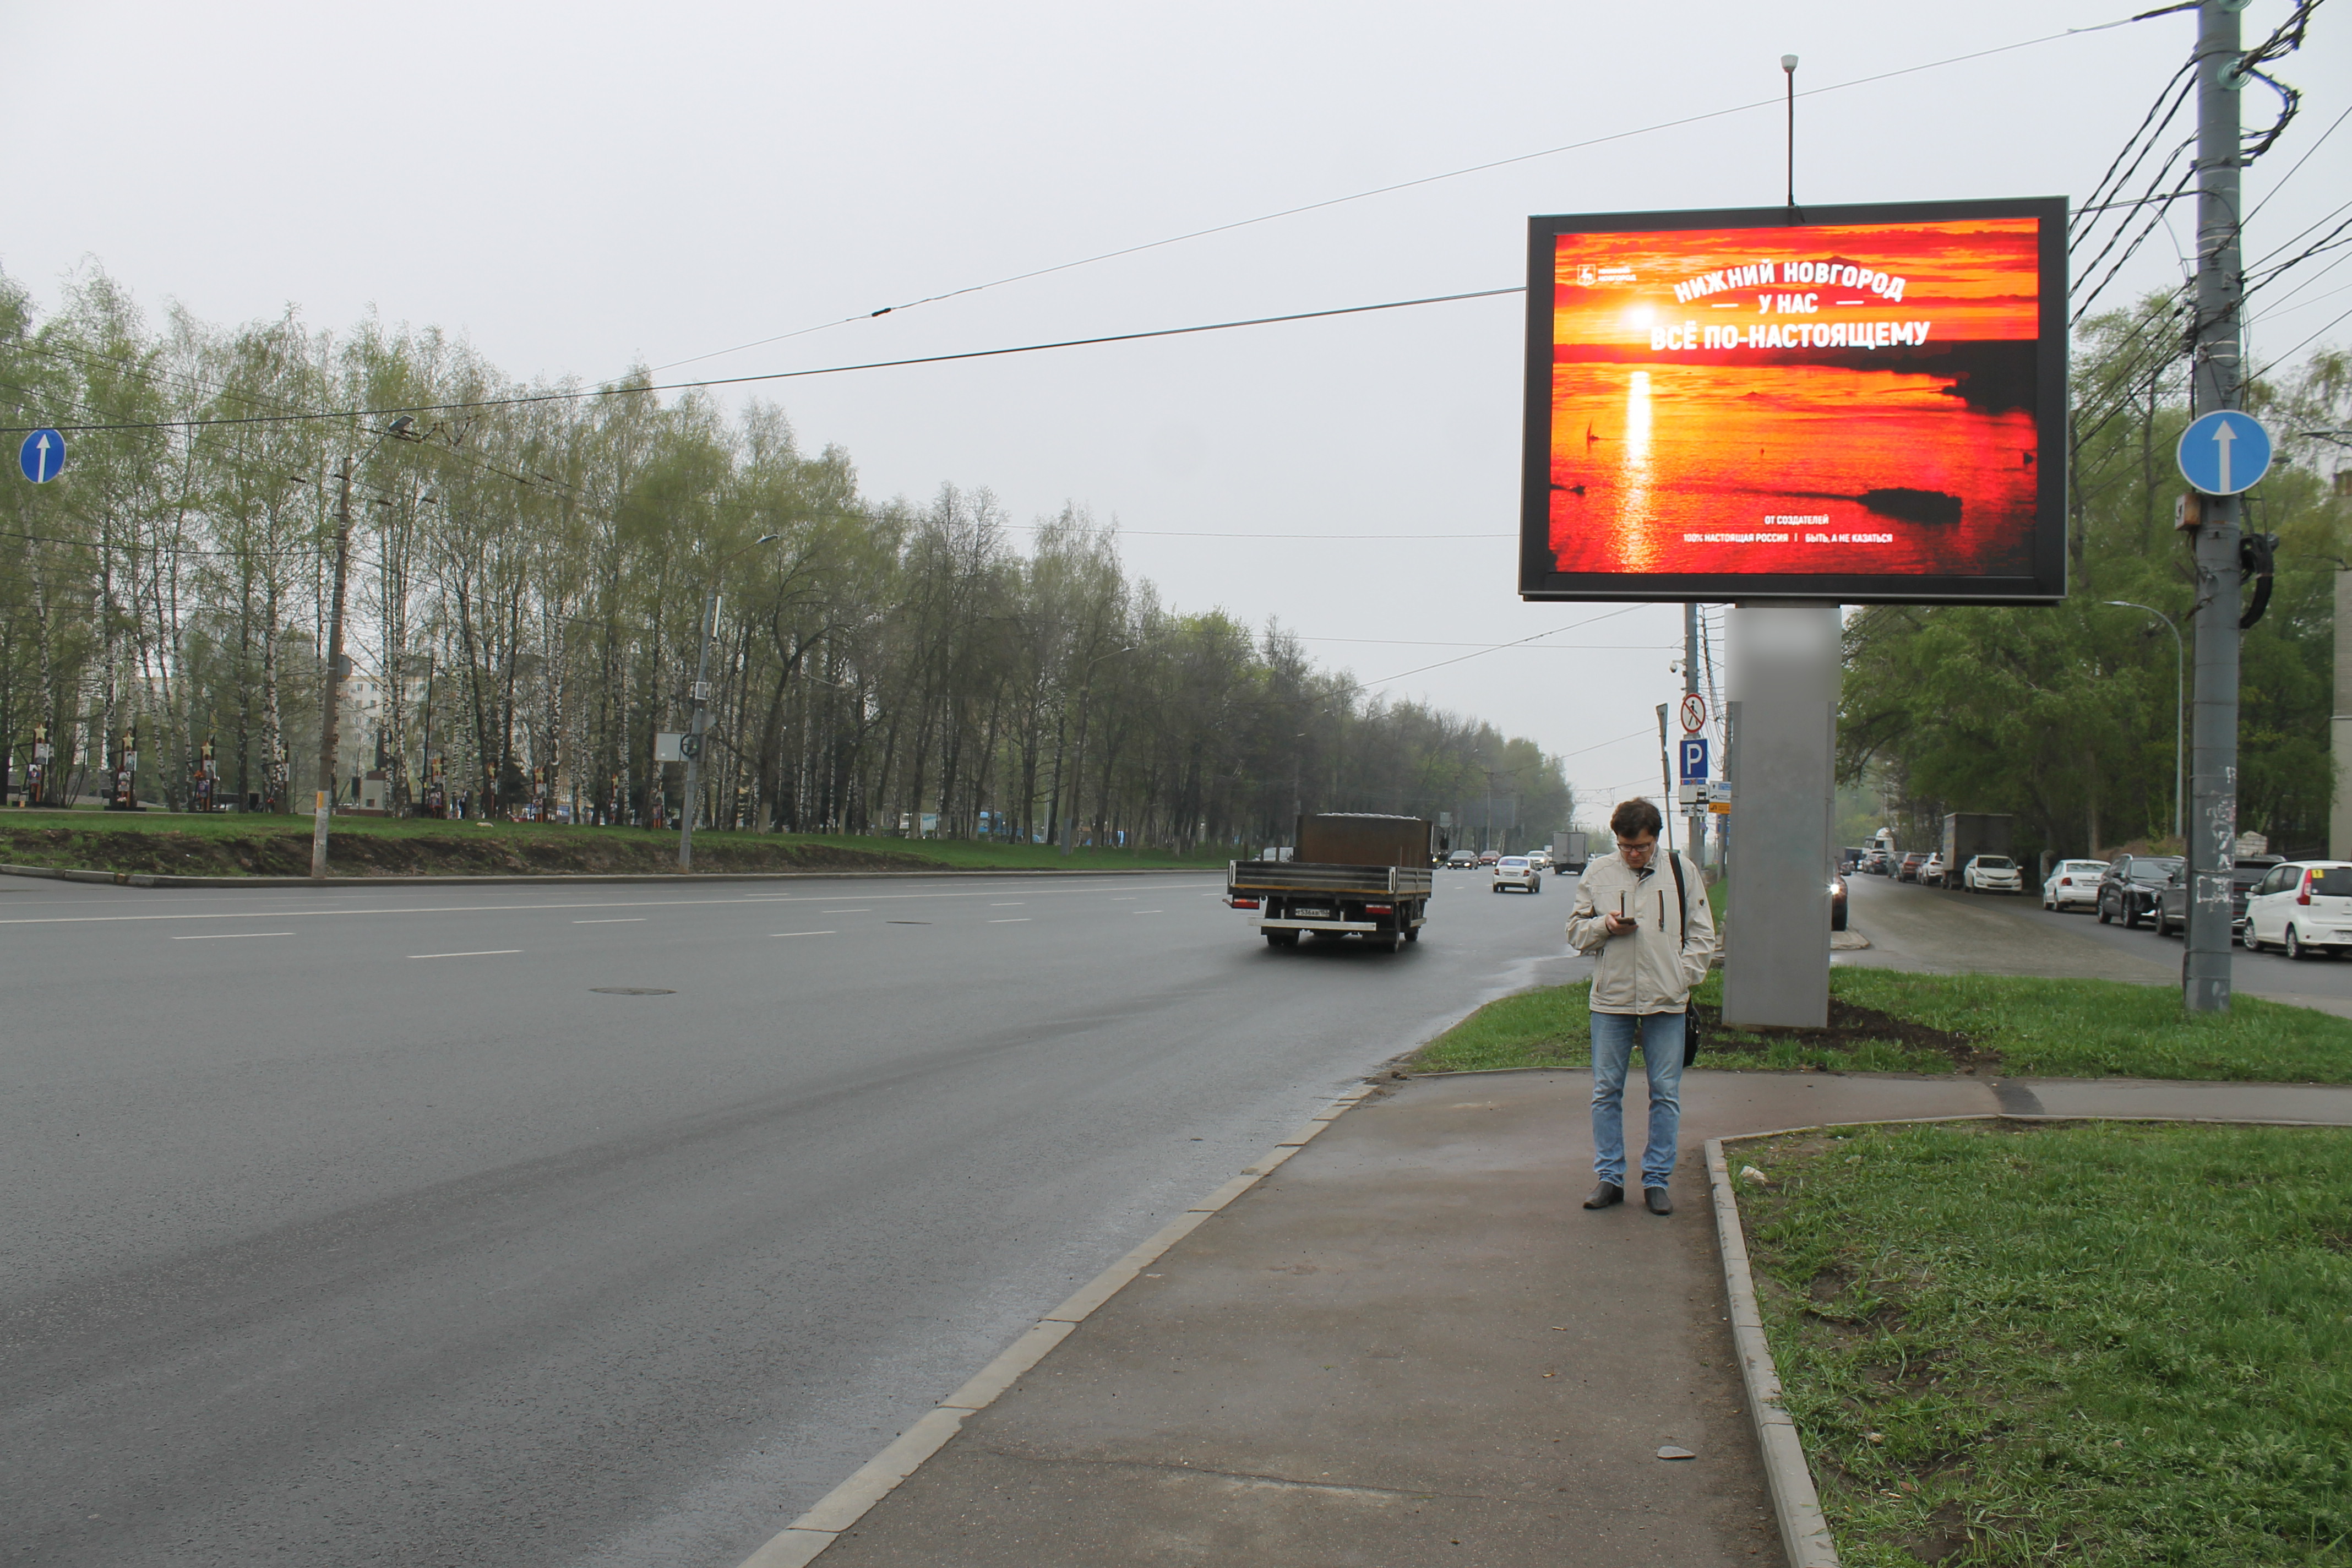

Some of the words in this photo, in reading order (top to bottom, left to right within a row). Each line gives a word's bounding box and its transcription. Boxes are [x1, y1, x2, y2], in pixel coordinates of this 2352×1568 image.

[1673, 258, 1775, 303] НИЖНИЙ
[1783, 261, 1907, 302] НОВГОРОД
[1758, 294, 1773, 314] У
[1777, 293, 1818, 313] НАС
[1651, 321, 1697, 350] ВСЁ
[1704, 321, 1931, 350] ПО-НАСТОЯЩЕМУ
[1764, 515, 1775, 525] ОТ
[1777, 514, 1830, 525] СОЗДАТЕЛЕЙ
[1683, 533, 1703, 542] 100%
[1704, 533, 1755, 543] НАСТОЯЩАЯ
[1756, 533, 1789, 542] РОССИЯ
[1805, 533, 1831, 543] БЫТЬ,
[1831, 533, 1838, 542] А
[1838, 533, 1850, 542] НЕ
[1851, 533, 1893, 543] КАЗАТЬСЯ
[1686, 743, 1703, 775] P
